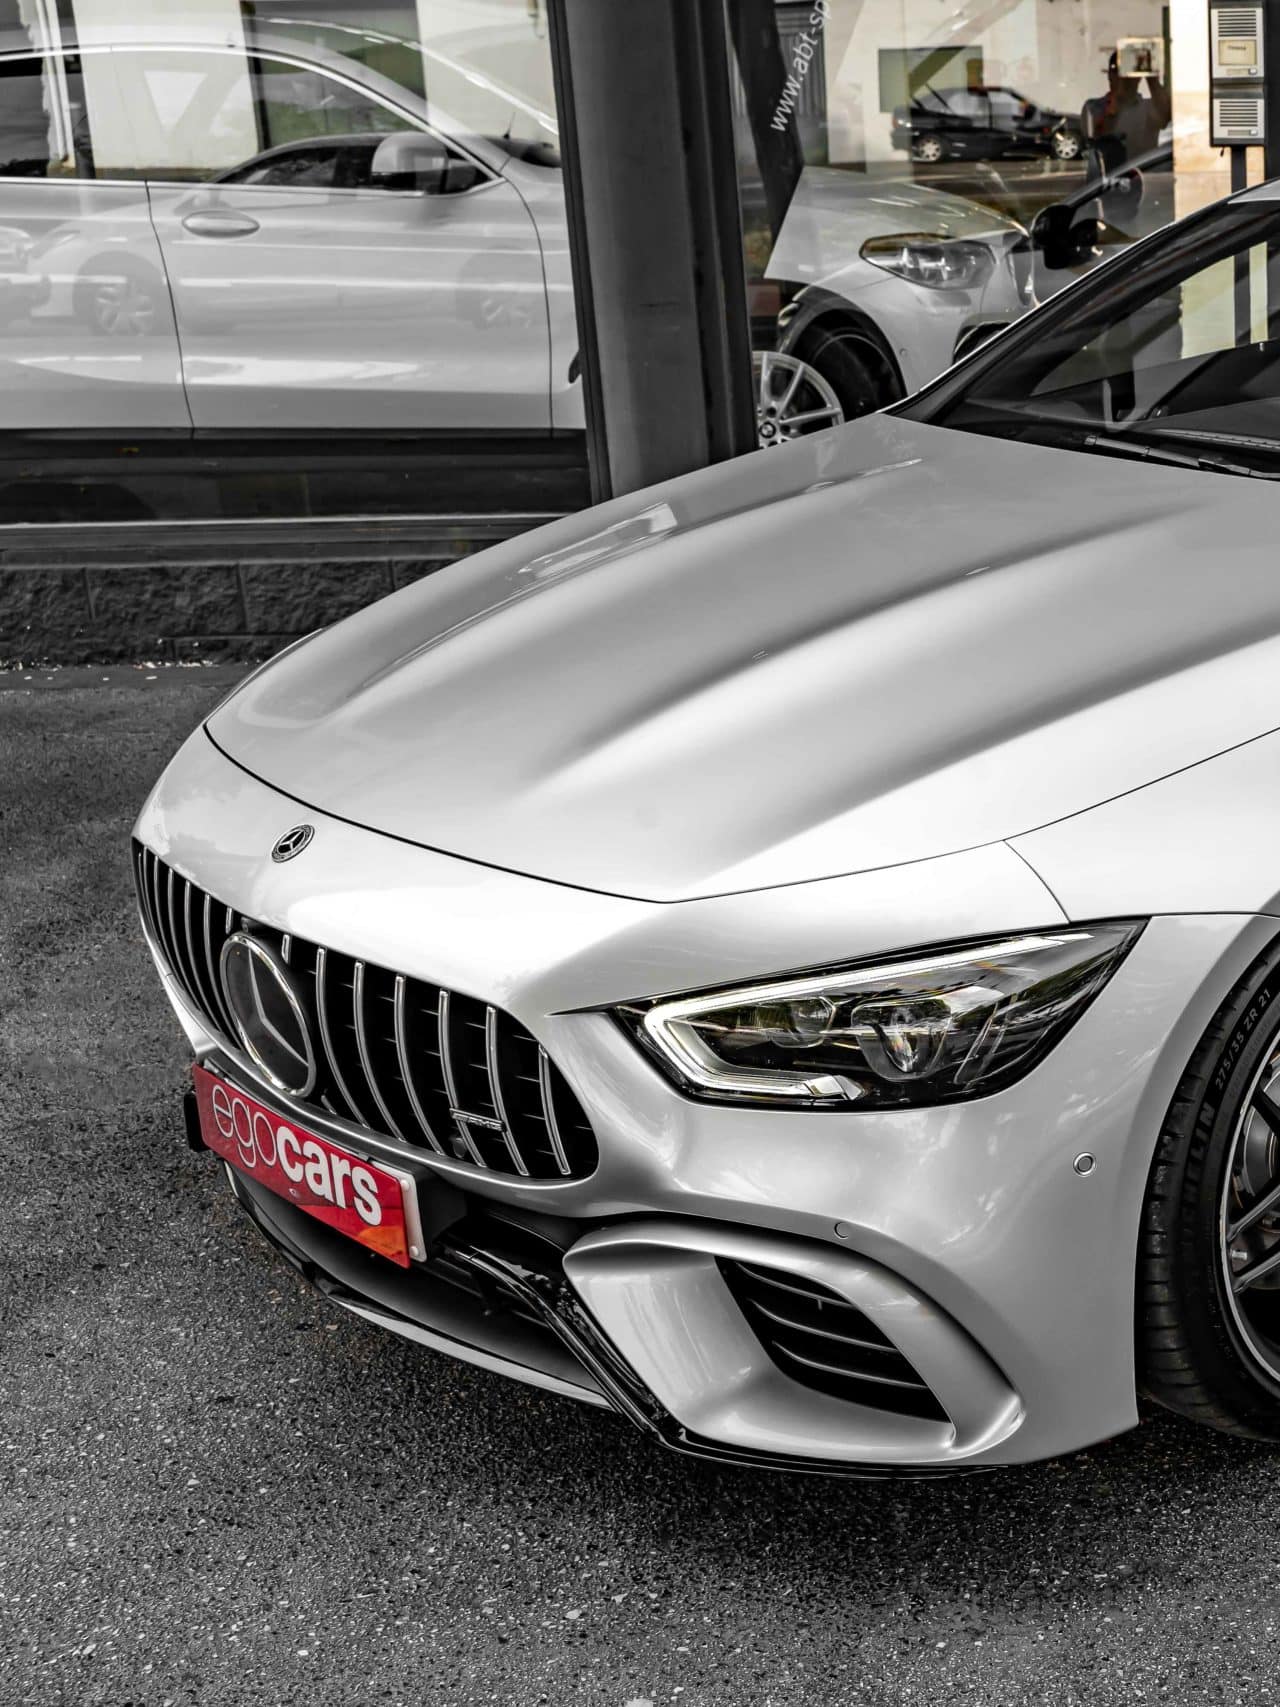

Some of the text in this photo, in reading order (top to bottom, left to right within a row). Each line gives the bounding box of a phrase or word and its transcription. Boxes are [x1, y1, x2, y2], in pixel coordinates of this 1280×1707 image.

[1243, 1007, 1258, 1031] ZR
[1258, 988, 1271, 1008] 21
[211, 1083, 383, 1227] egocars
